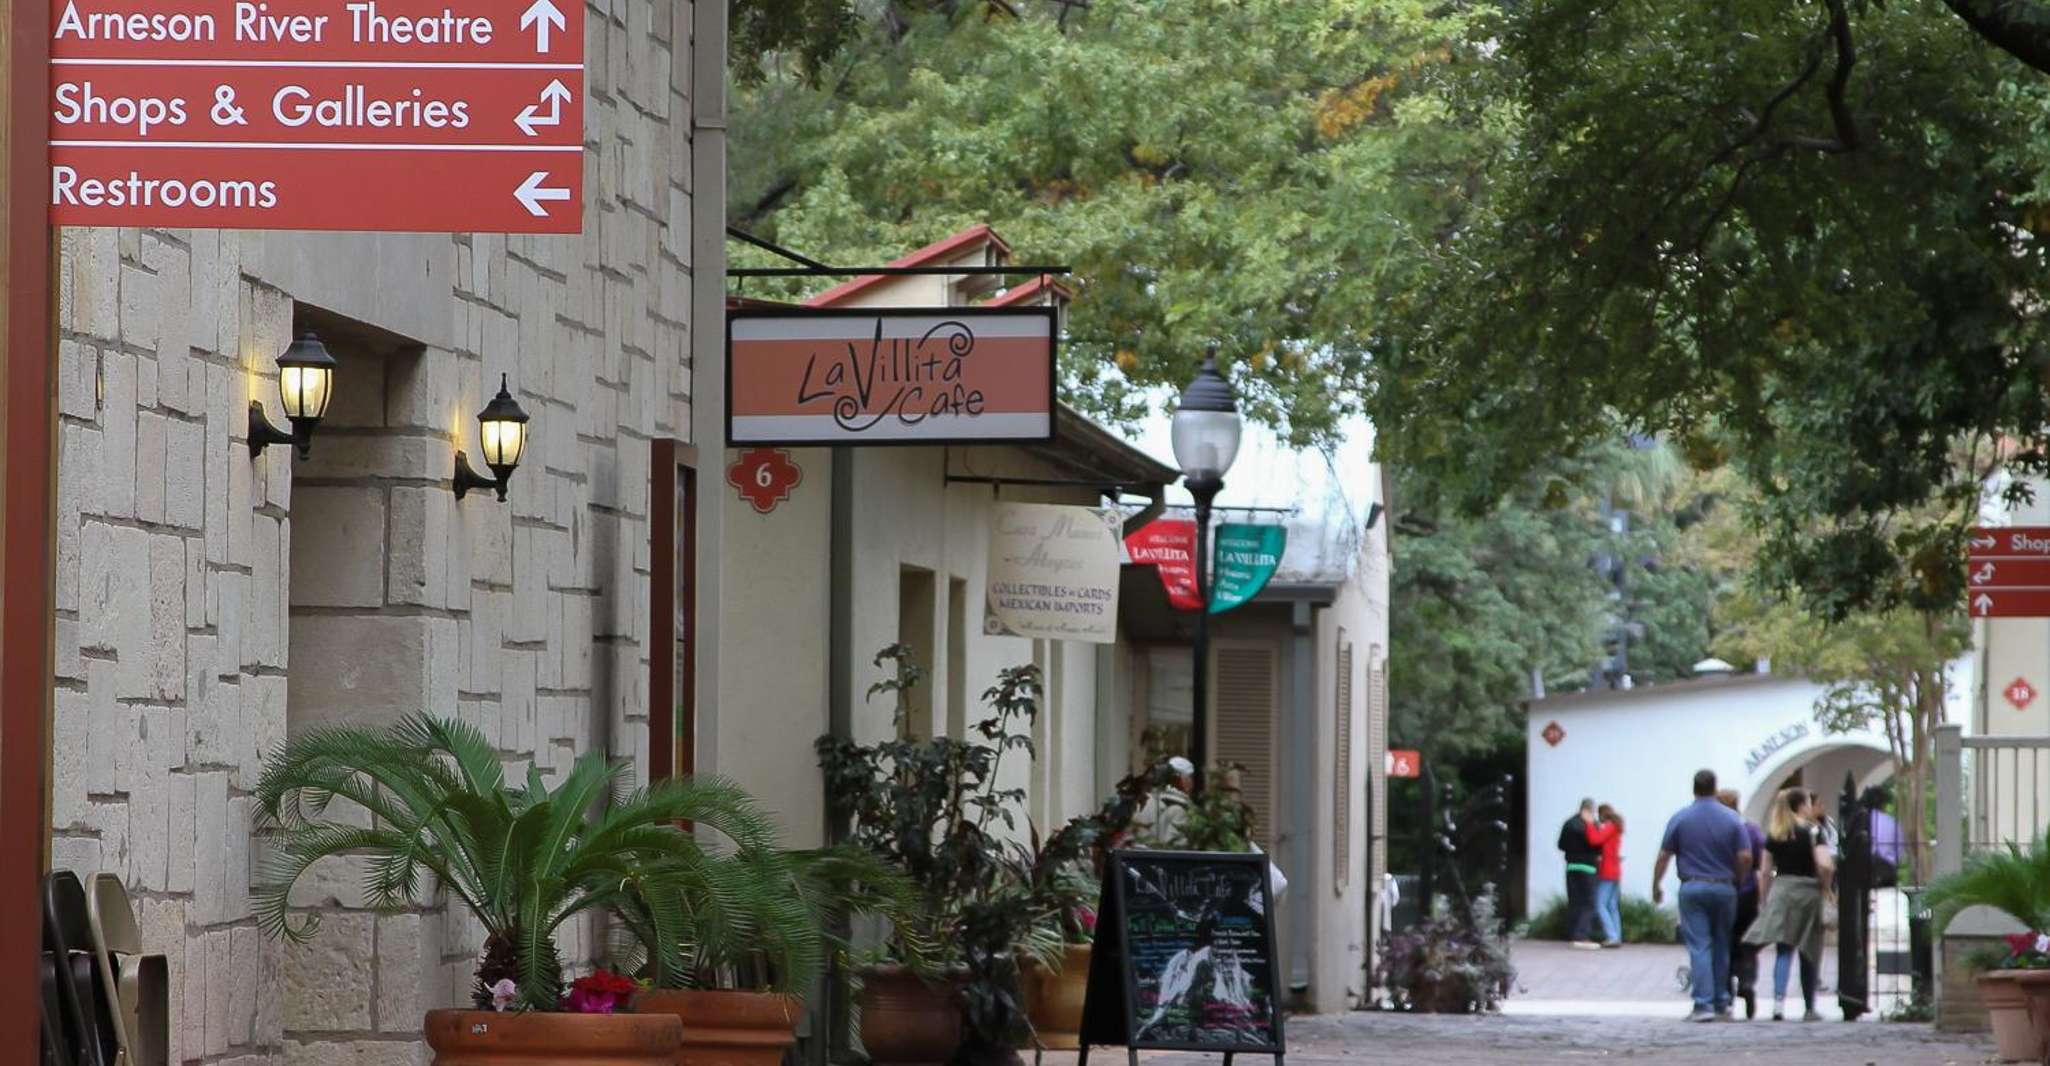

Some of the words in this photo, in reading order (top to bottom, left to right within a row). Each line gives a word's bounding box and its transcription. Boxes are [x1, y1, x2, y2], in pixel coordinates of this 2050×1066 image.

[55, 0, 214, 42] Arneson
[235, 2, 328, 42] River
[346, 1, 493, 44] Theatre
[54, 82, 187, 135] Shops
[210, 85, 248, 126] &
[273, 85, 470, 129] Galleries
[52, 166, 277, 209] Restrooms
[798, 352, 844, 404] La
[848, 317, 974, 410] Villita
[900, 383, 985, 424] Cafe
[756, 462, 772, 487] 6
